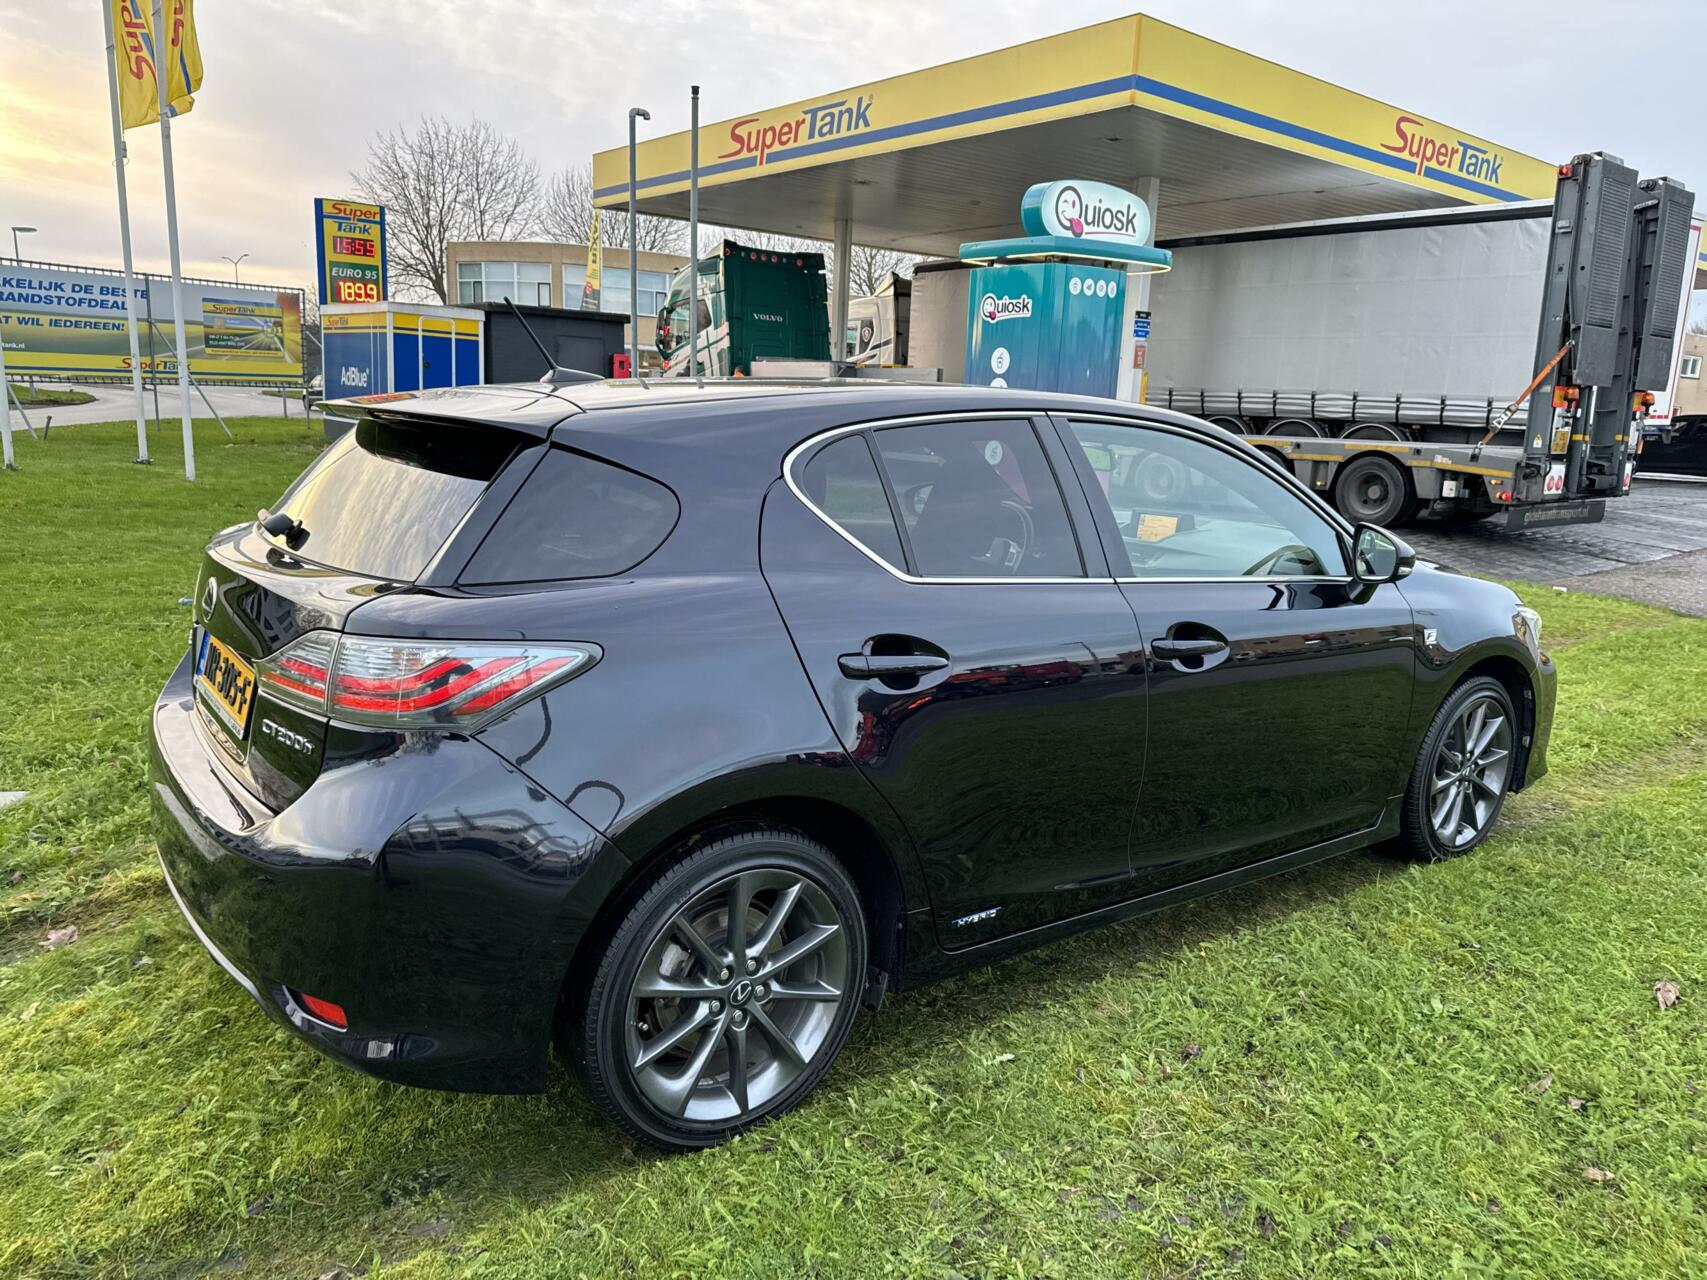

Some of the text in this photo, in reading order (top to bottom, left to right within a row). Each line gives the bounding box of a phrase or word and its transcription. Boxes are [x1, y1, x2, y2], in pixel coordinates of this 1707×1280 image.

[718, 95, 873, 166] SuperTank
[1380, 116, 1502, 184] SuperTank
[323, 202, 379, 222] Super
[1055, 186, 1137, 237] Quiosk
[333, 221, 372, 235] Tank
[331, 267, 378, 280] EURO 95
[0, 277, 66, 293] KELIJK
[71, 283, 94, 295] DE
[981, 294, 1031, 320] Quiosk
[16, 316, 44, 327] WIL
[48, 318, 125, 331] IEDEREEN!
[752, 312, 784, 323] VOLVO
